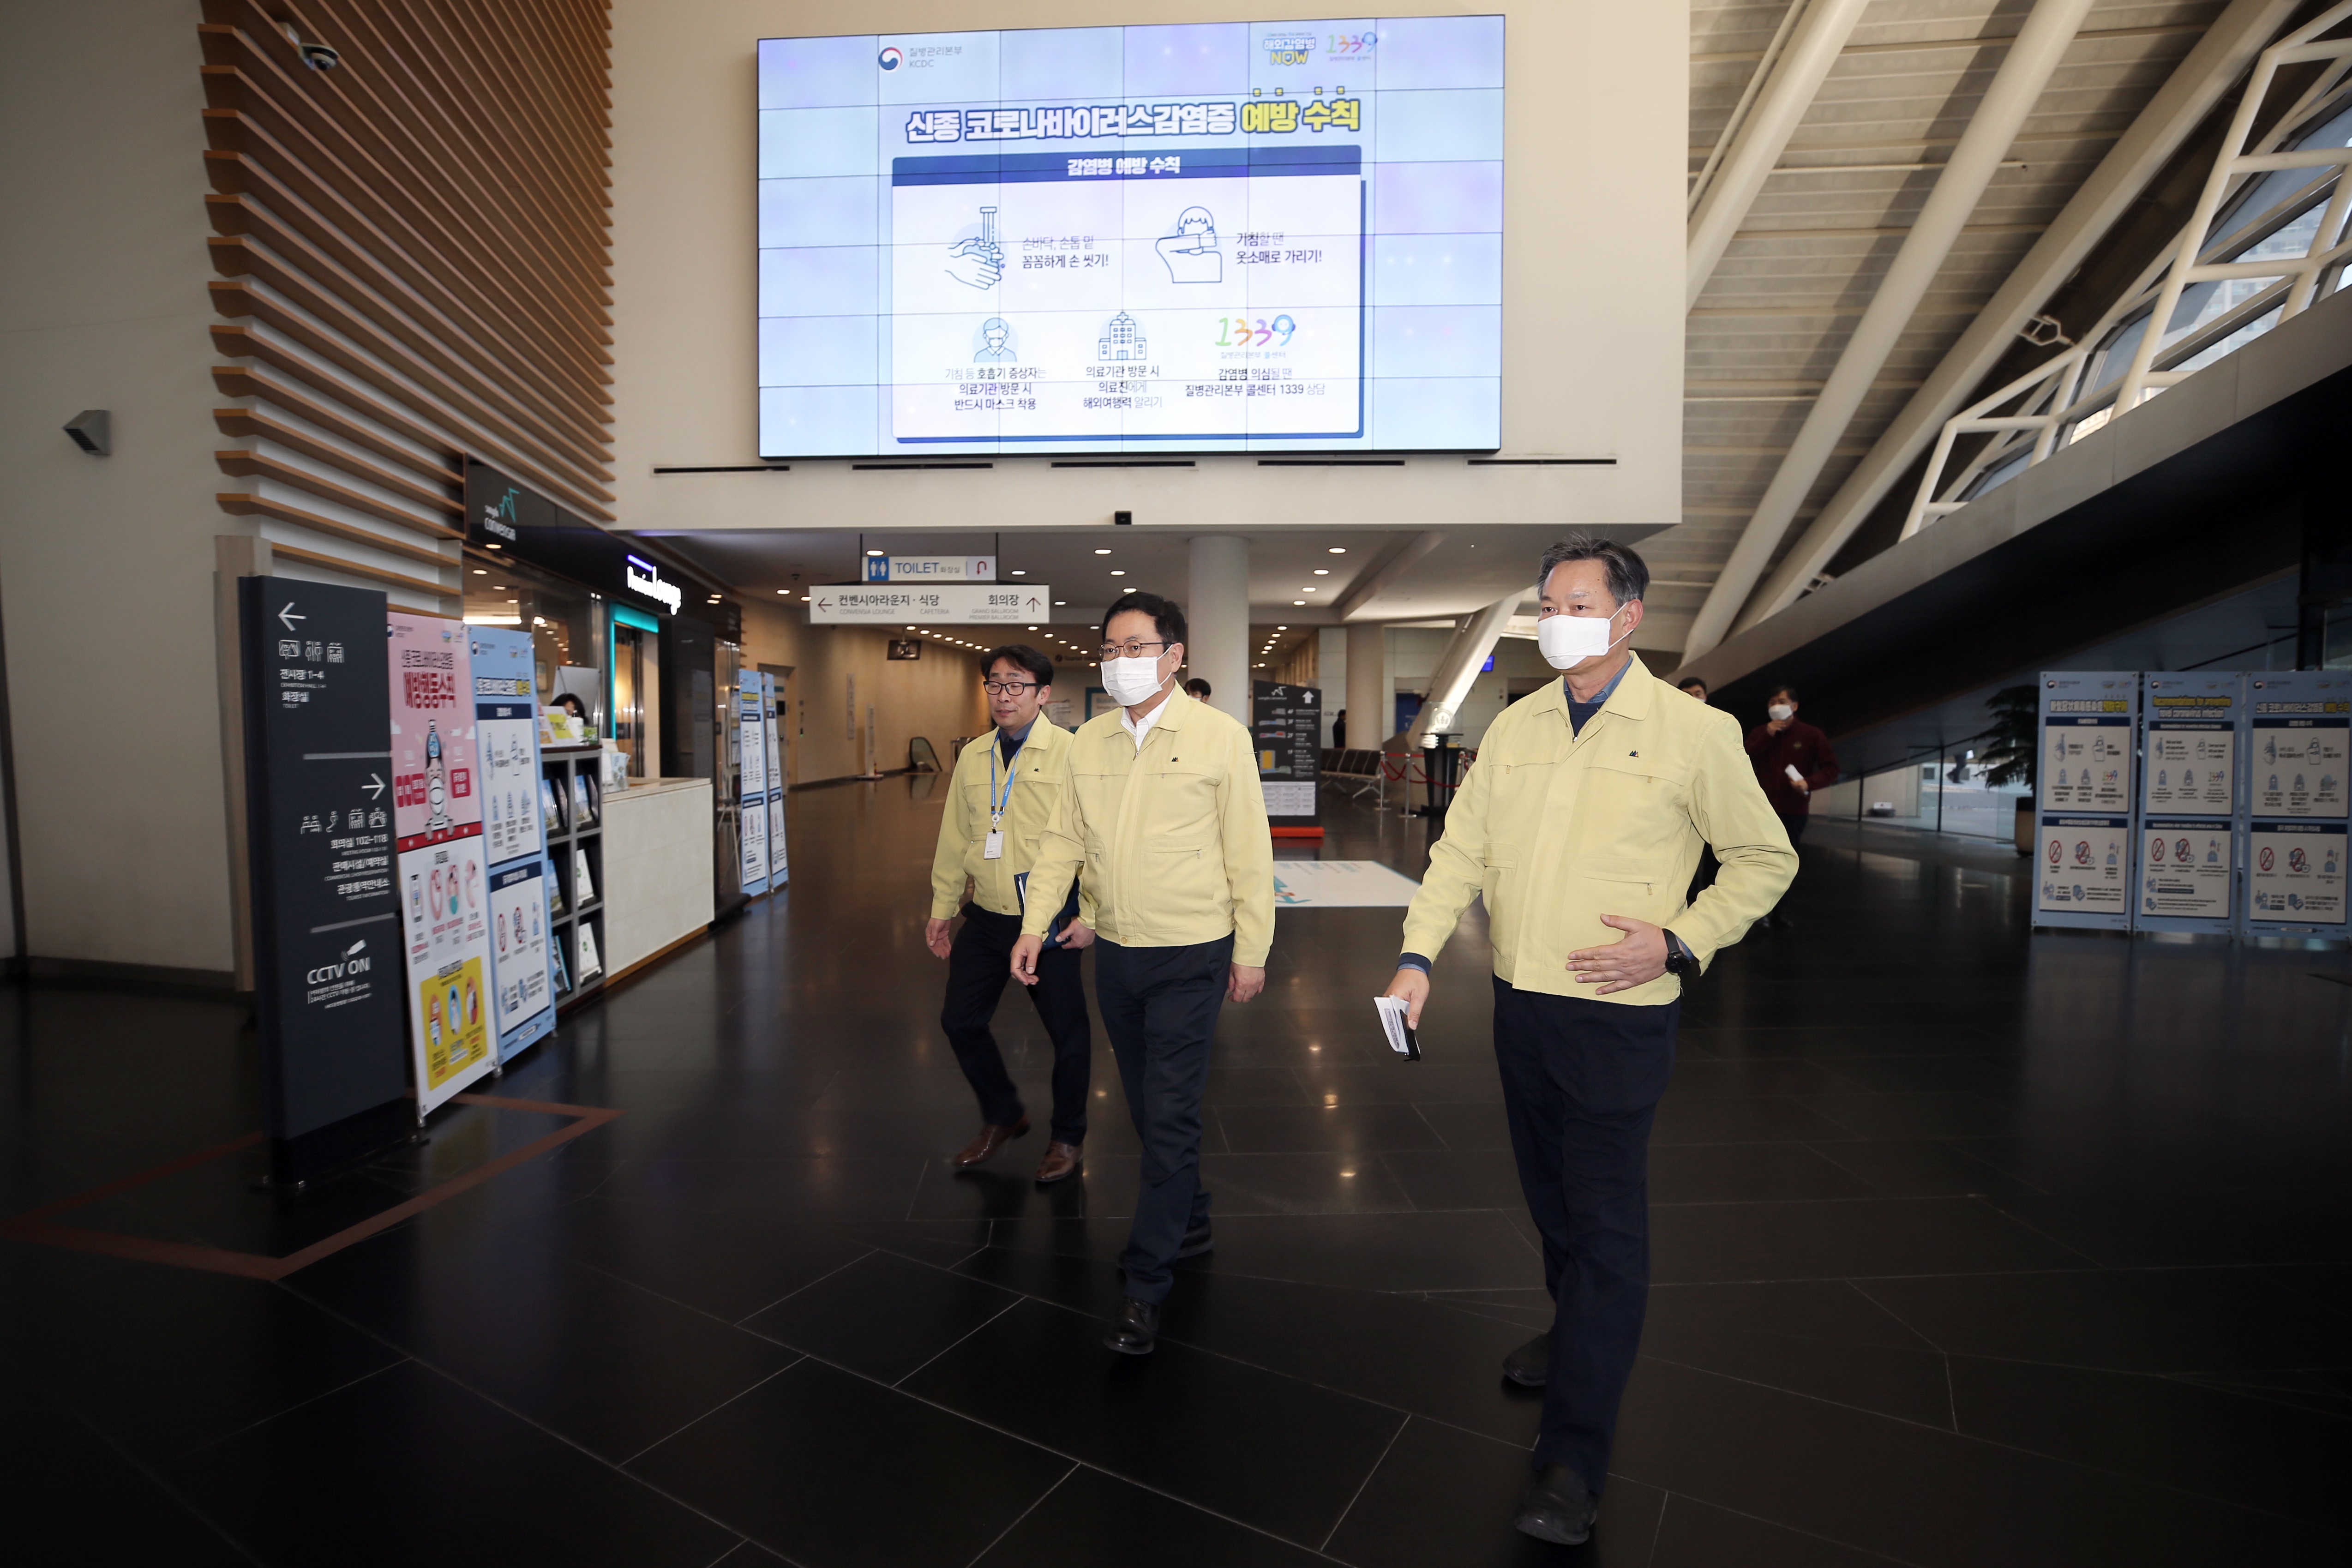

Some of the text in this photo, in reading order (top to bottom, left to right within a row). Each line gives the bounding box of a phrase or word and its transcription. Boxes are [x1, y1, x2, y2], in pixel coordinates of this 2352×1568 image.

[1326, 31, 1378, 54] 1339
[909, 46, 962, 57] 질병관리본부
[1271, 50, 1309, 66] NOW
[909, 60, 935, 68] KCDC
[906, 98, 1361, 143] 신종 코로나바이러스감염증 예방 수칙
[1068, 156, 1181, 176] 감염병 예방 수칙
[1060, 235, 1080, 250] 손톱
[1083, 235, 1094, 249] 밑
[1022, 253, 1109, 269] 꼼꼼하게 손 씻기!
[1236, 249, 1322, 264] 옷소매로 가리기!
[1215, 314, 1296, 346] 1339
[945, 366, 1047, 380] 기침 등 호흡기 증상자는
[1086, 365, 1159, 378] 의료기관 방문 시
[1218, 368, 1292, 380] 감염병 의심될 땐
[959, 382, 1032, 395] 의료기관 방문 시
[1098, 381, 1147, 393] 의료진에게
[1185, 383, 1326, 397] 질병관리본부 콜센터 1339 상담
[954, 398, 1037, 410] 반드시 마스크 착용
[1083, 396, 1162, 409] 해외여행력 알리기
[894, 562, 940, 574] TOILET
[839, 594, 940, 606] 컨벤시아라운지 식당
[988, 594, 1020, 606] 회의장
[280, 669, 307, 680] 전시장
[282, 691, 310, 702] 화장실
[355, 833, 389, 845] 102-118
[307, 956, 371, 985] CCTV ON
